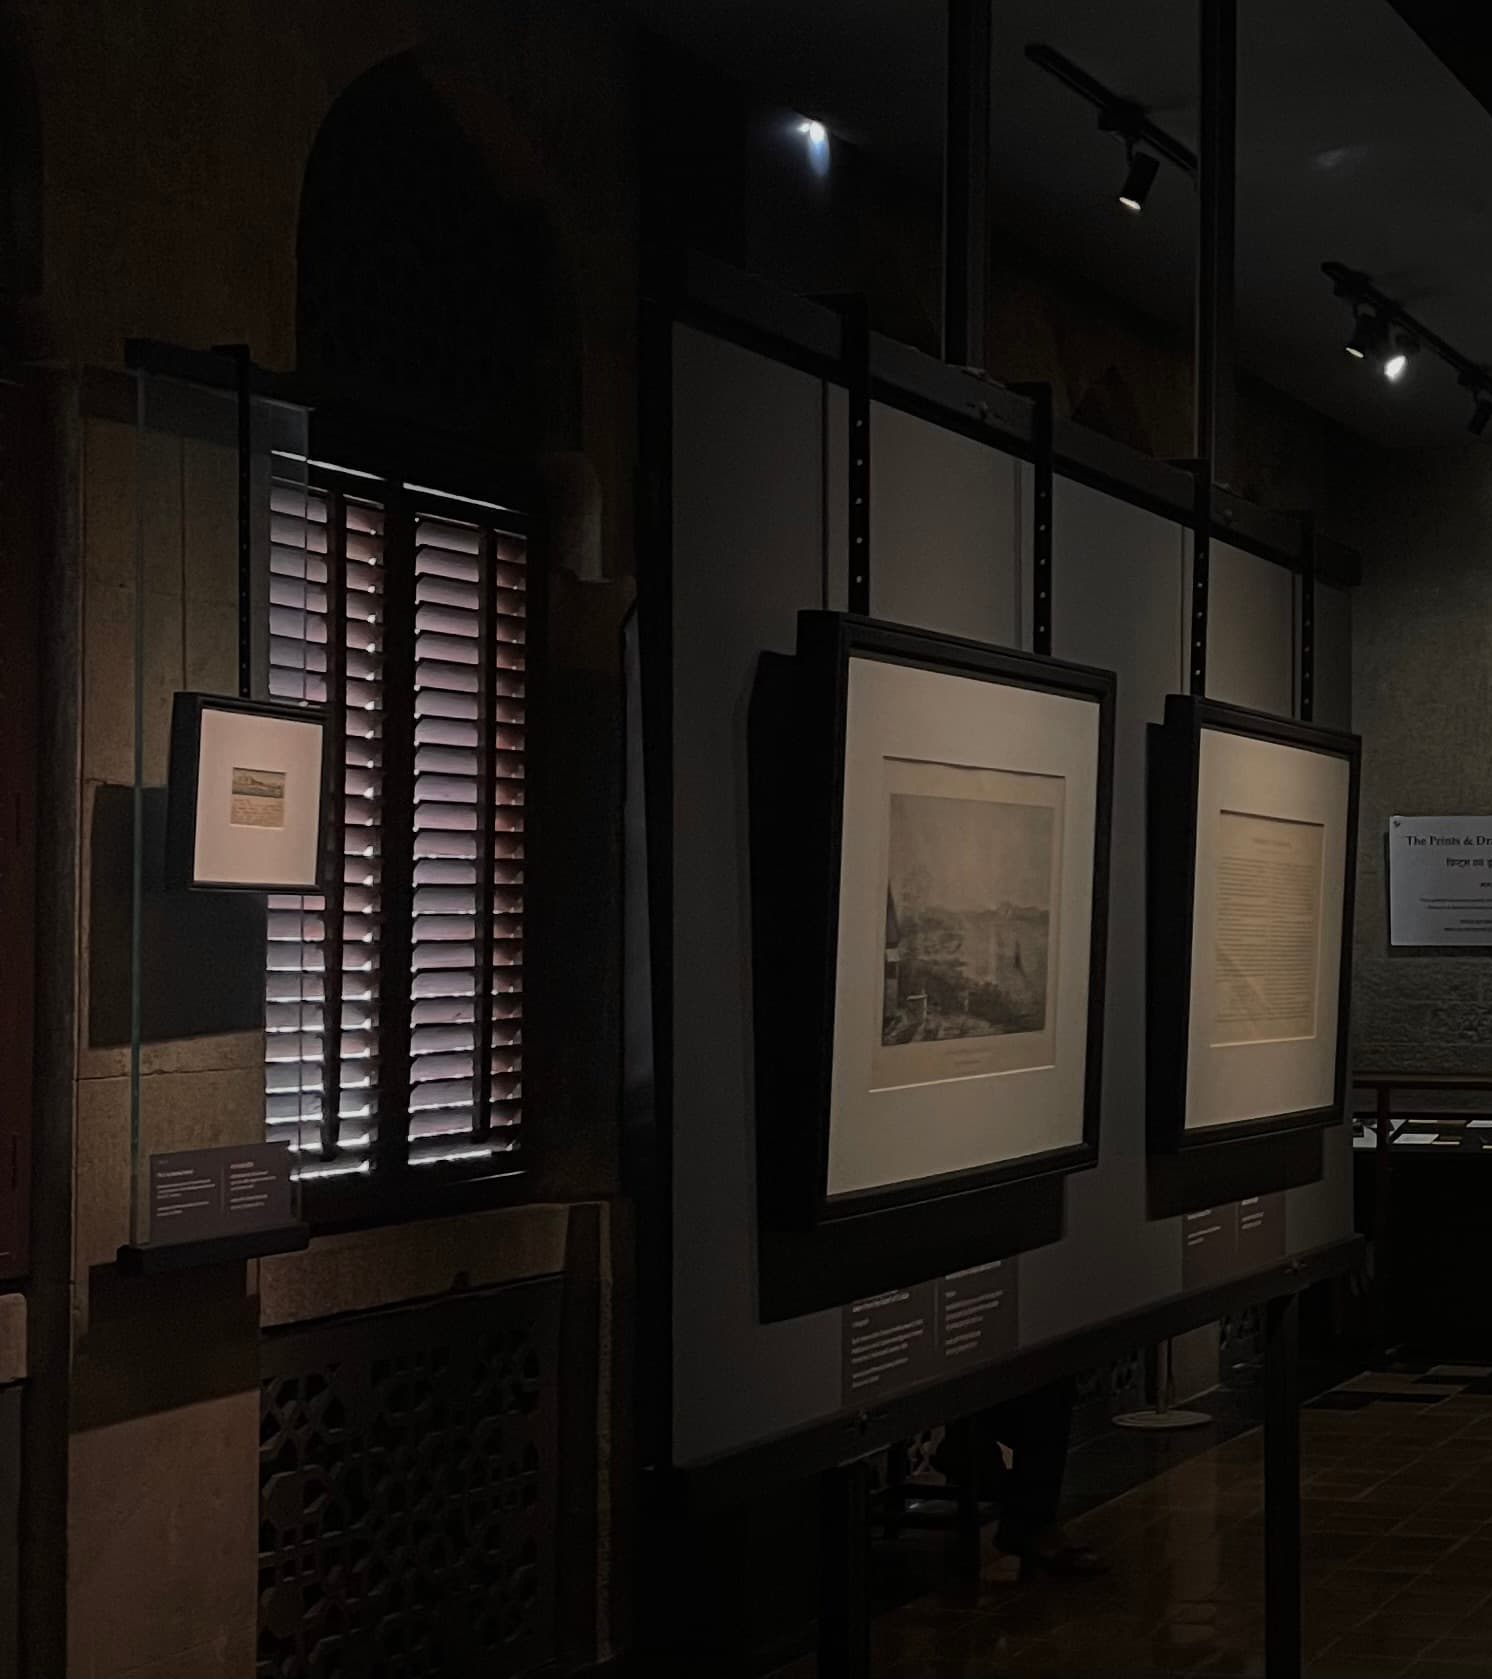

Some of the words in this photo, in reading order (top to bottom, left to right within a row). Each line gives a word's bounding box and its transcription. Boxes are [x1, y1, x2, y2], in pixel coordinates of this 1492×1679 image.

[1406, 835, 1426, 846] The
[1430, 835, 1460, 846] Prints
[1463, 837, 1473, 846] &
